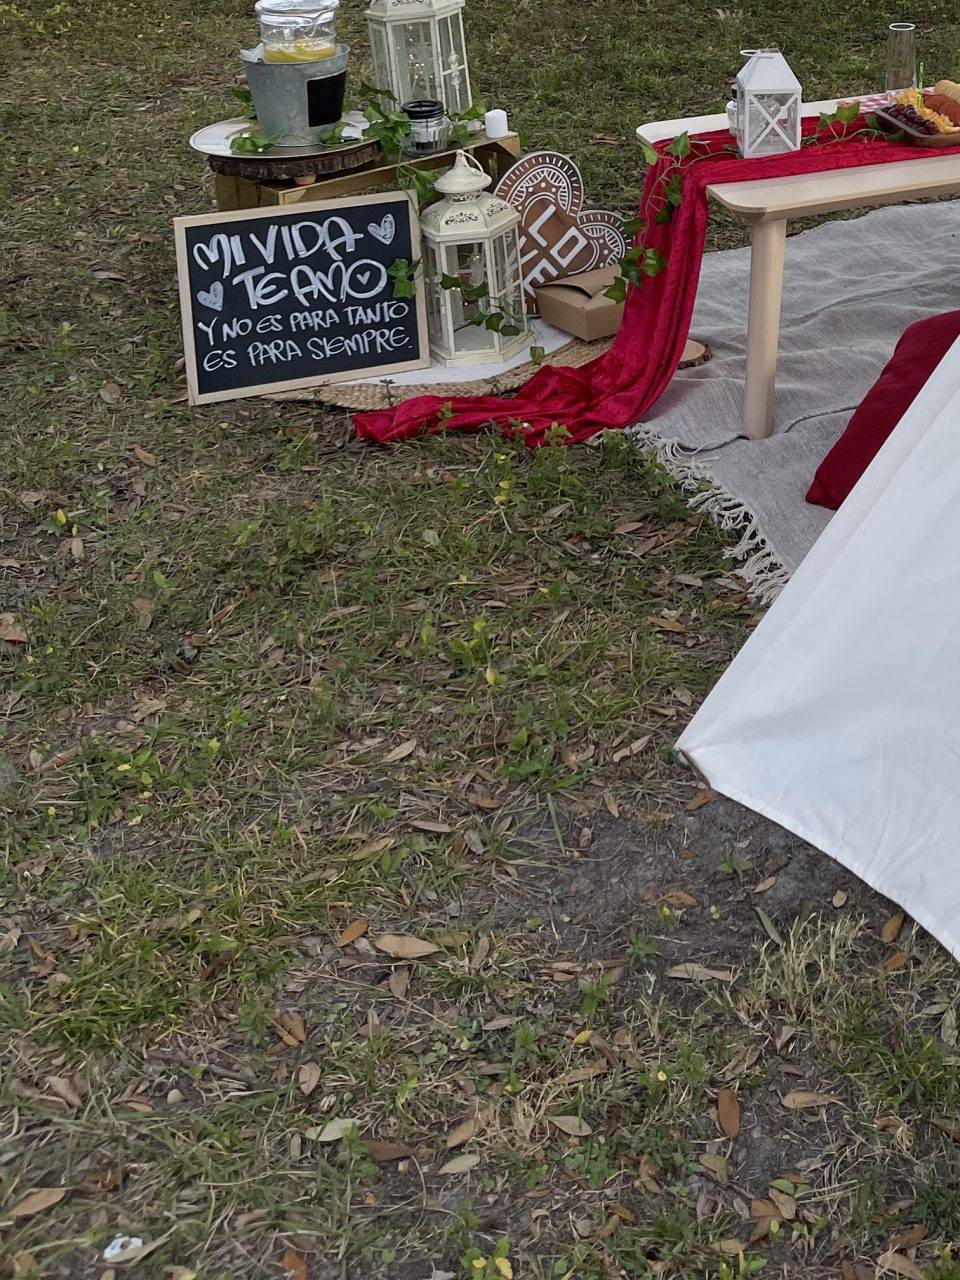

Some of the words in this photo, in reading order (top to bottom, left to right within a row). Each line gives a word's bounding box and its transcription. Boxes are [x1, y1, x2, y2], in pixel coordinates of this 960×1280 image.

[193, 233, 246, 278] MI
[250, 216, 364, 264] VIDA
[232, 265, 289, 309] TE
[290, 258, 388, 307] AMO
[197, 317, 218, 346] Y
[222, 318, 252, 342] NO
[255, 314, 282, 334] ES
[289, 308, 340, 332] PARA
[342, 300, 410, 326] TANTO
[203, 350, 238, 371] ES
[247, 339, 302, 367] PARA
